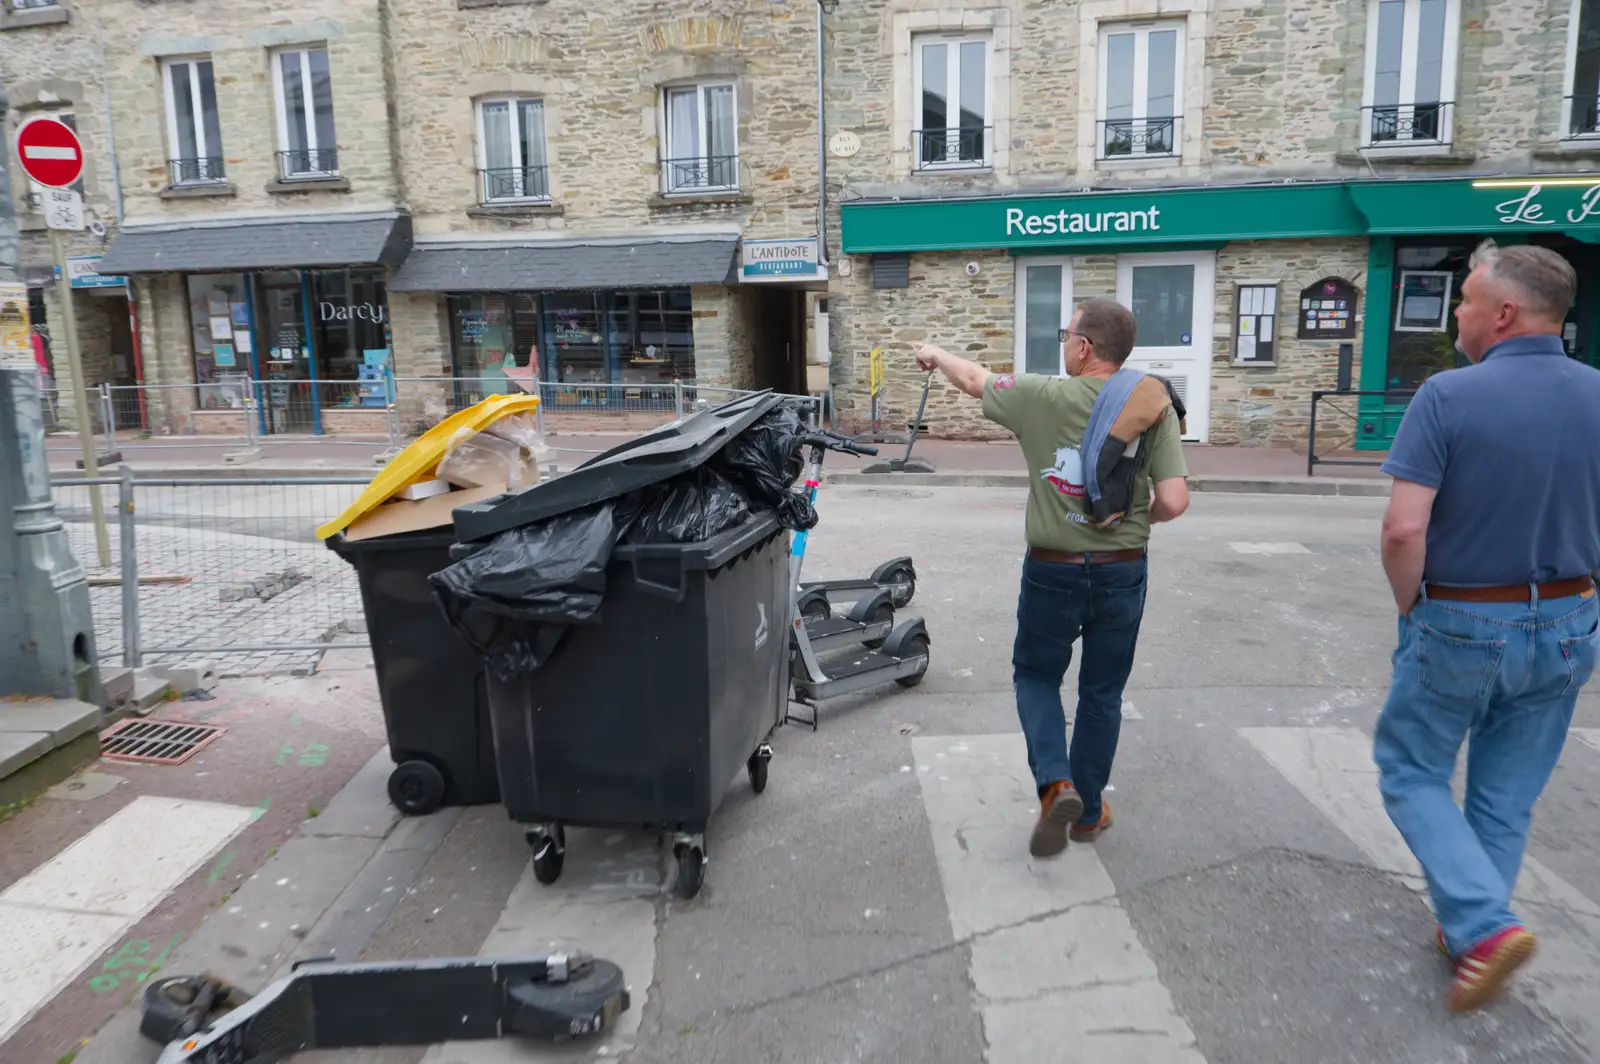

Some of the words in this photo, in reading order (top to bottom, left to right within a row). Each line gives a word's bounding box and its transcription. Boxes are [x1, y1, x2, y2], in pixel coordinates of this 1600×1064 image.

[51, 190, 72, 202] SAUF
[1495, 184, 1556, 224] Le
[1006, 204, 1160, 236] Restaurant
[751, 245, 809, 259] L'ANTIDOTE
[319, 301, 385, 324] Darcy
